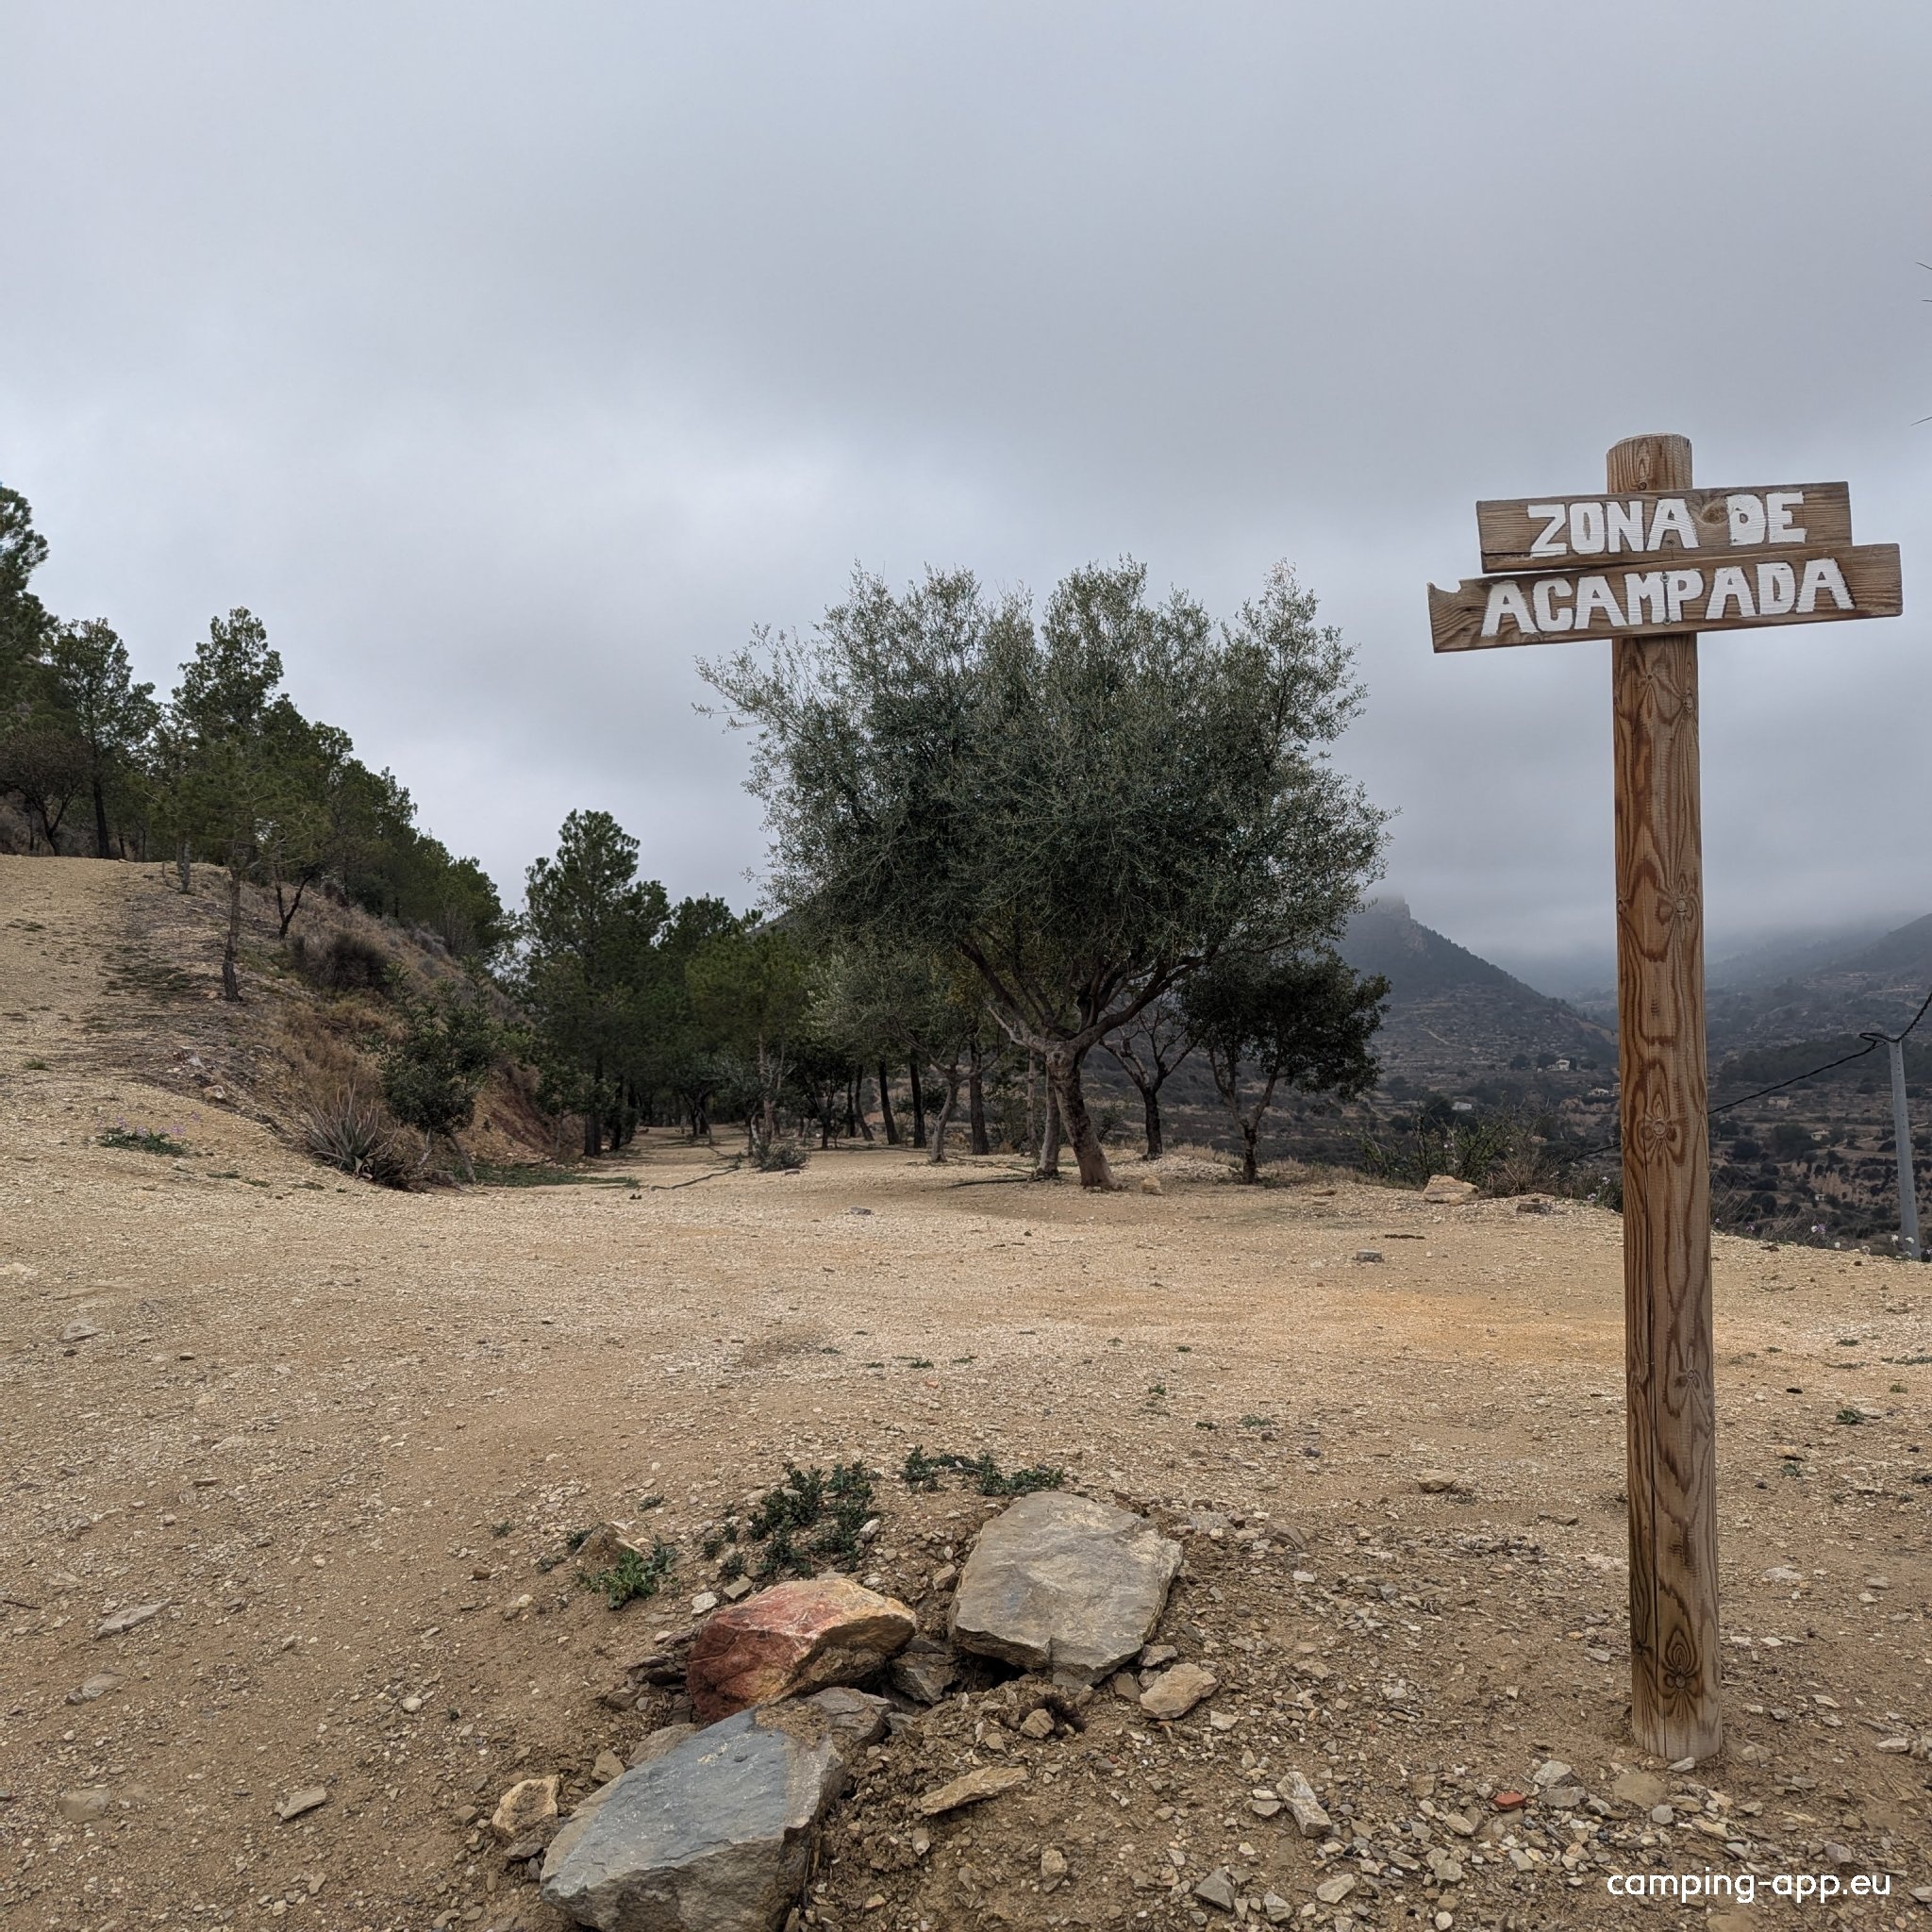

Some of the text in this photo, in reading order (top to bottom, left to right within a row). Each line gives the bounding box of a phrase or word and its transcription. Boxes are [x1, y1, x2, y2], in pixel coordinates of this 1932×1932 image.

[1527, 491, 1807, 558] ZONA DE
[1480, 558, 1856, 638] ACAMPADA
